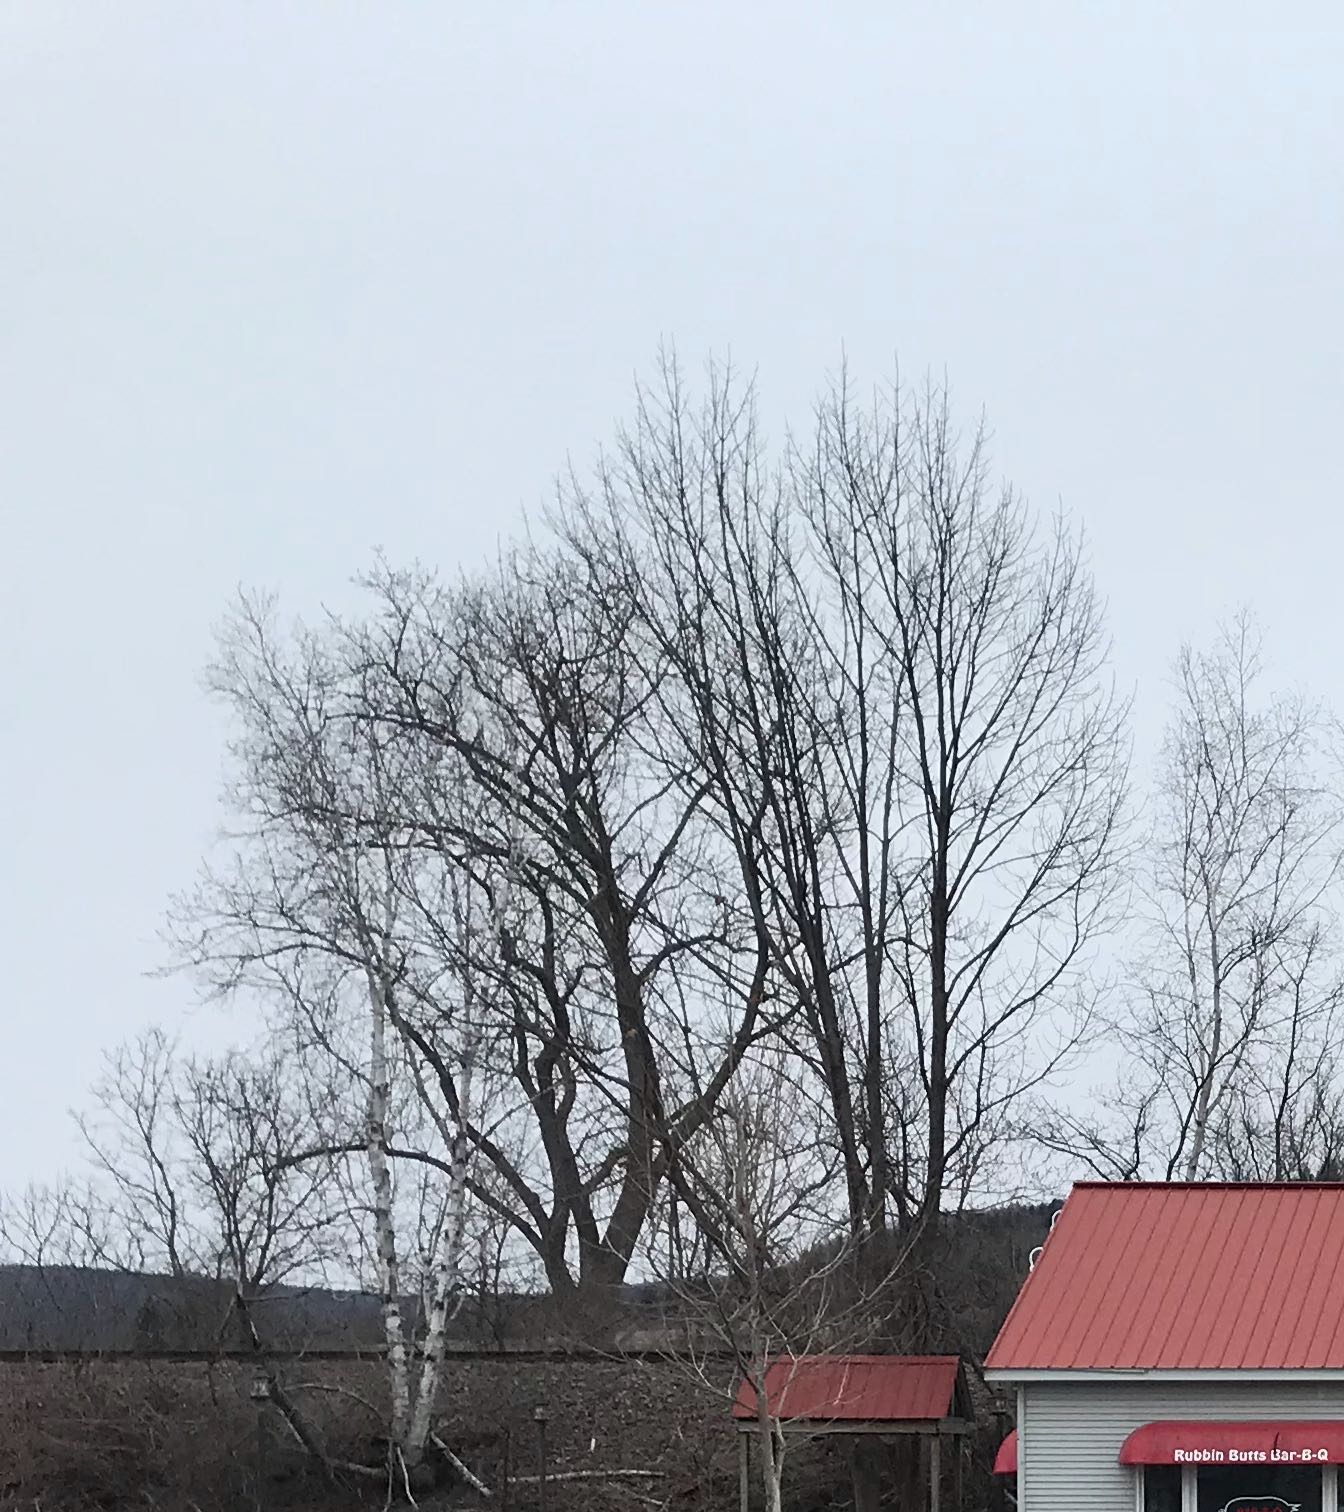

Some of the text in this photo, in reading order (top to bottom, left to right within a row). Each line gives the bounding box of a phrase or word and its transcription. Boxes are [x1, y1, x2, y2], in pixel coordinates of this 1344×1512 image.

[1174, 1449, 1329, 1462] Rubbin Butts Bar-B-Q
